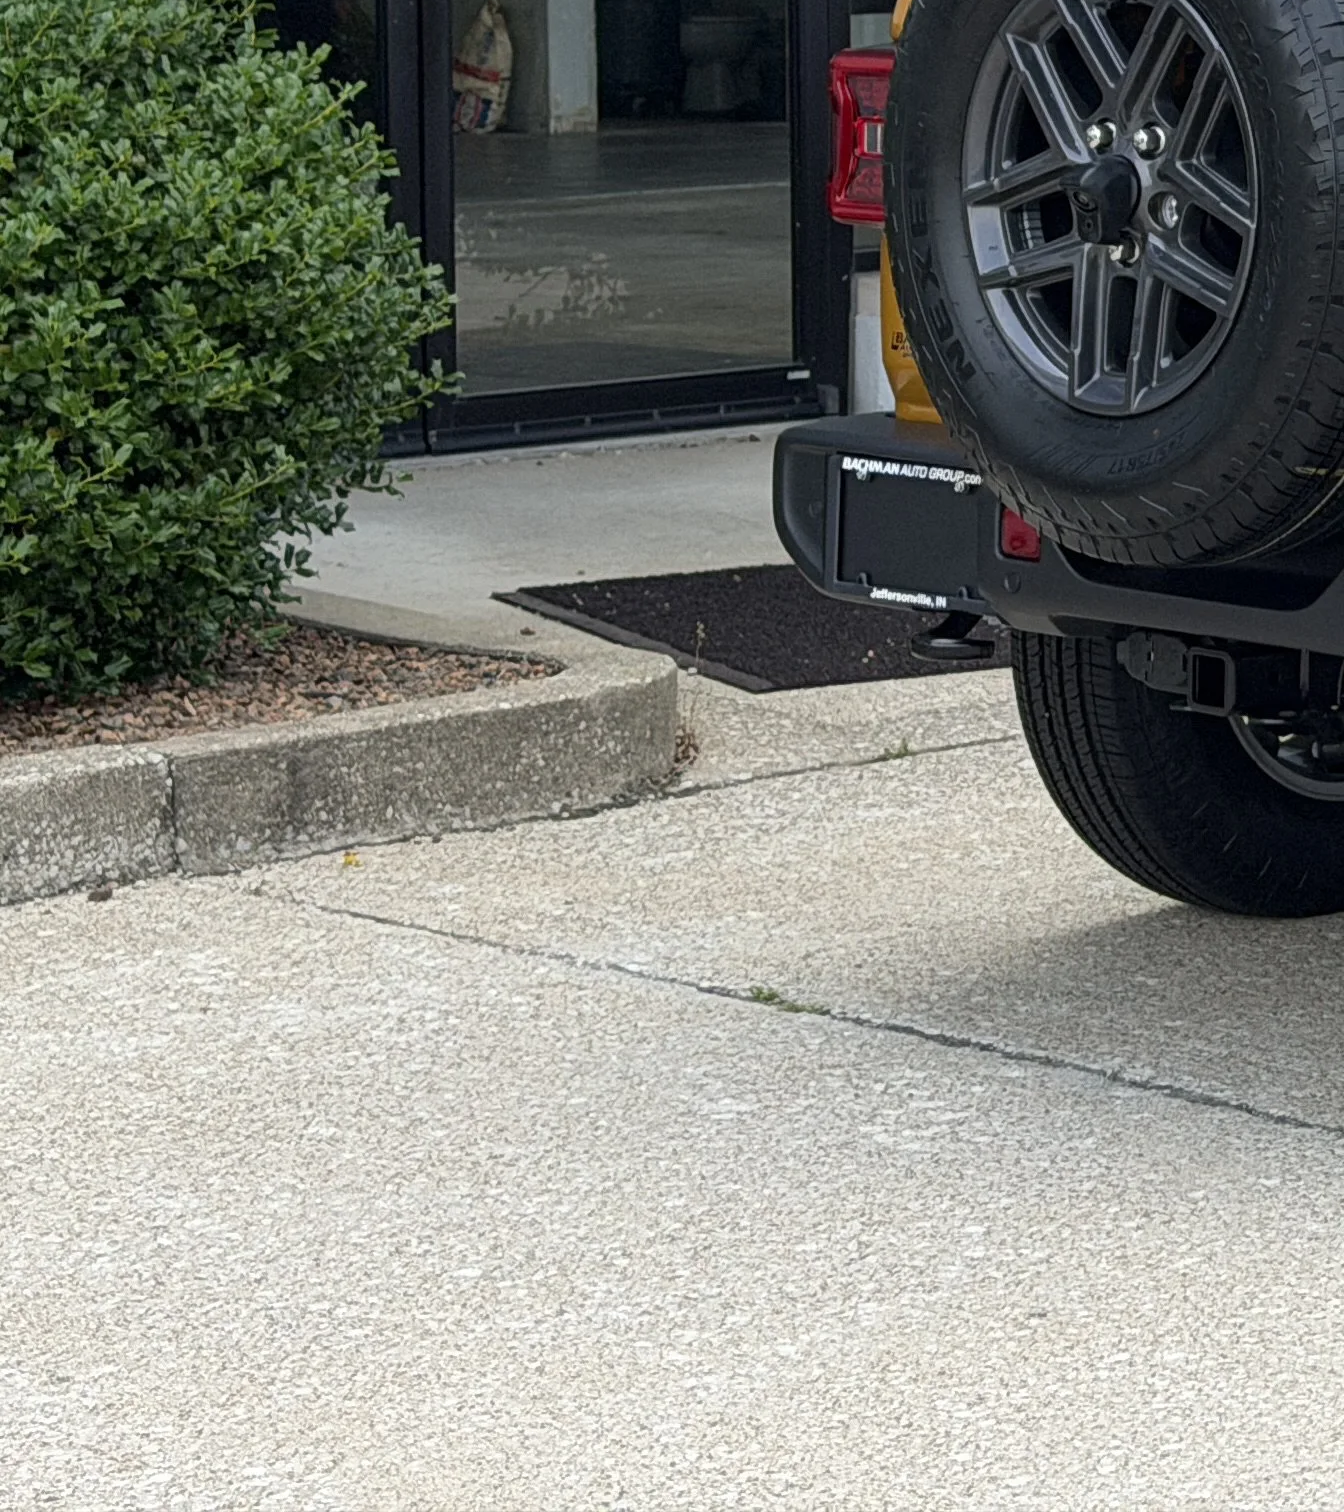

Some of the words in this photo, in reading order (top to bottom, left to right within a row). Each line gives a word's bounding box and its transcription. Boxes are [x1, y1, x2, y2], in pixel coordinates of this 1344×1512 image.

[842, 457, 900, 475] BACHMAN
[899, 463, 928, 479] AUTO
[935, 595, 947, 608] IN
